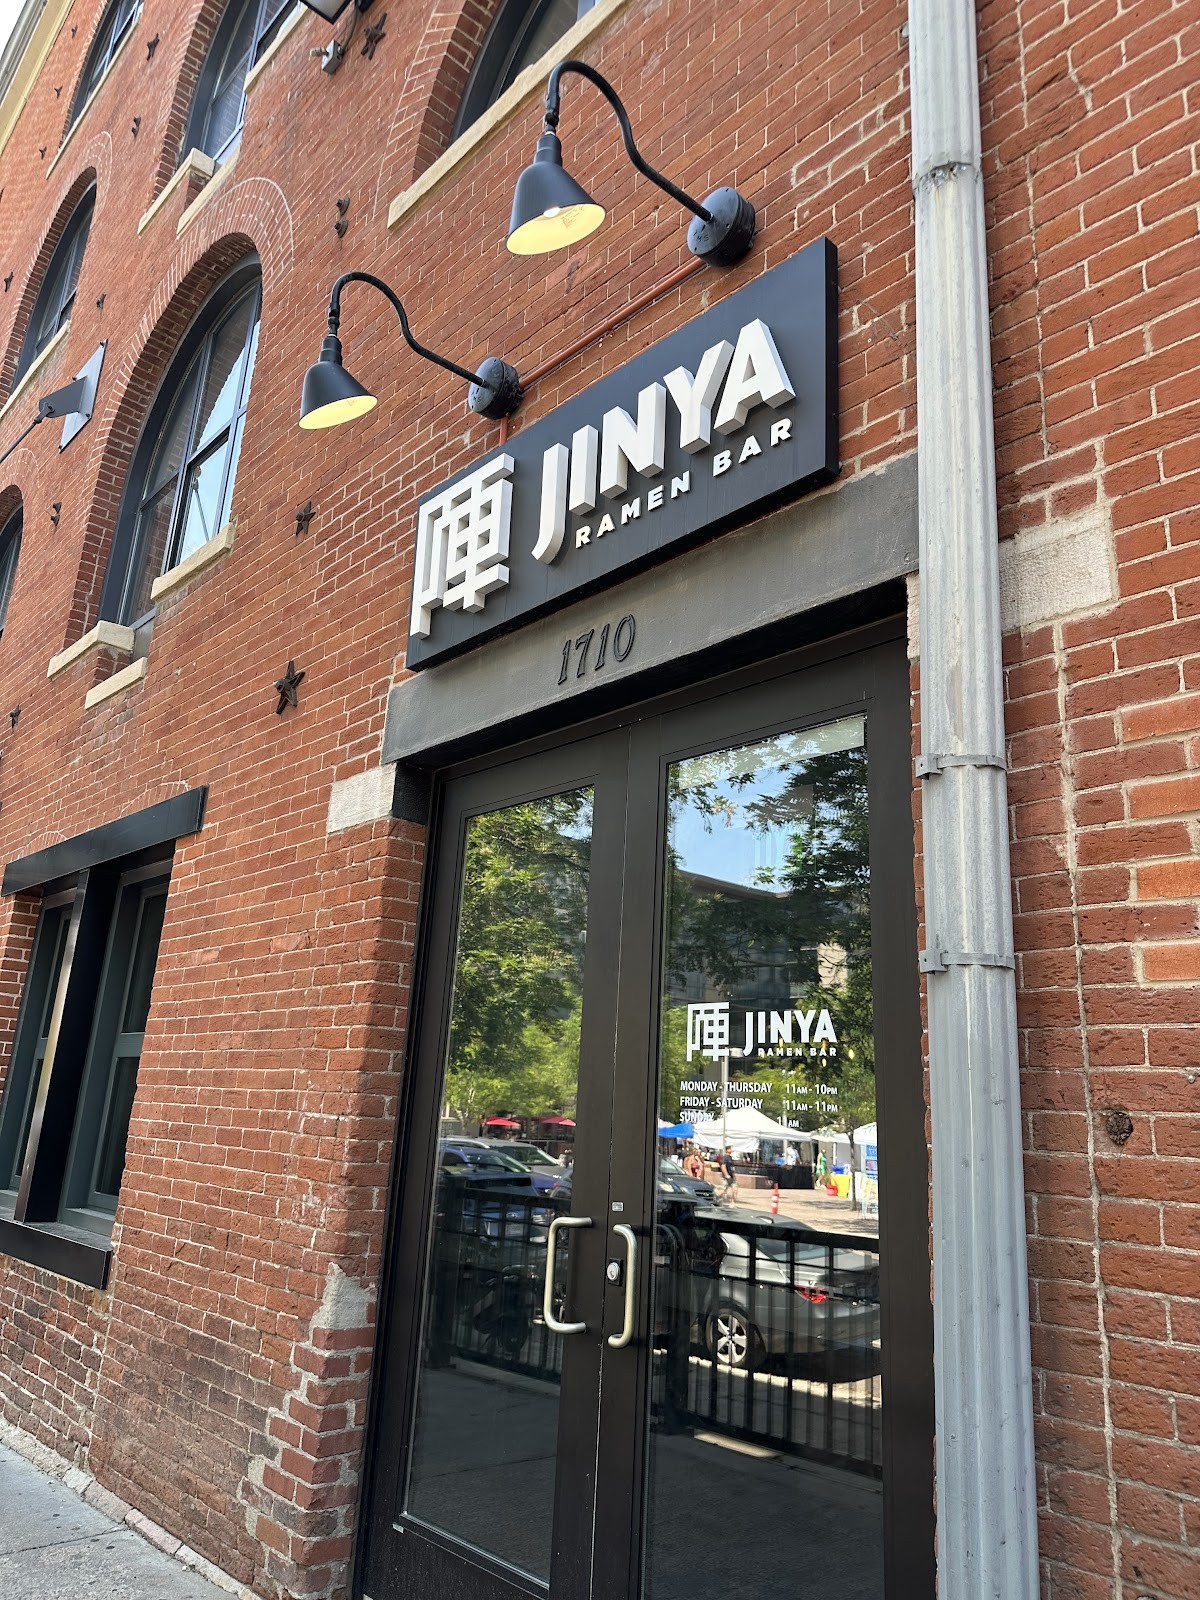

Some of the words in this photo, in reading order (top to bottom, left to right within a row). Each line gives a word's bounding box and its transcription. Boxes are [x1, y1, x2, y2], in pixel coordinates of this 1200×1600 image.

[531, 318, 796, 565] JINYA
[575, 470, 690, 549] RAMEN
[713, 418, 793, 477] BAR
[558, 613, 636, 685] 1710
[742, 1009, 838, 1057] JINYA
[757, 1047, 803, 1057] RAMEN
[810, 1047, 837, 1057] BAR
[680, 1081, 718, 1092] MONDAY
[724, 1082, 773, 1093] THURSDAY
[785, 1083, 807, 1094] 11AM
[815, 1083, 838, 1095] 10PM
[680, 1097, 711, 1107] FRIDAY
[716, 1098, 763, 1109] SATURDAY
[815, 1101, 838, 1112] 11PM
